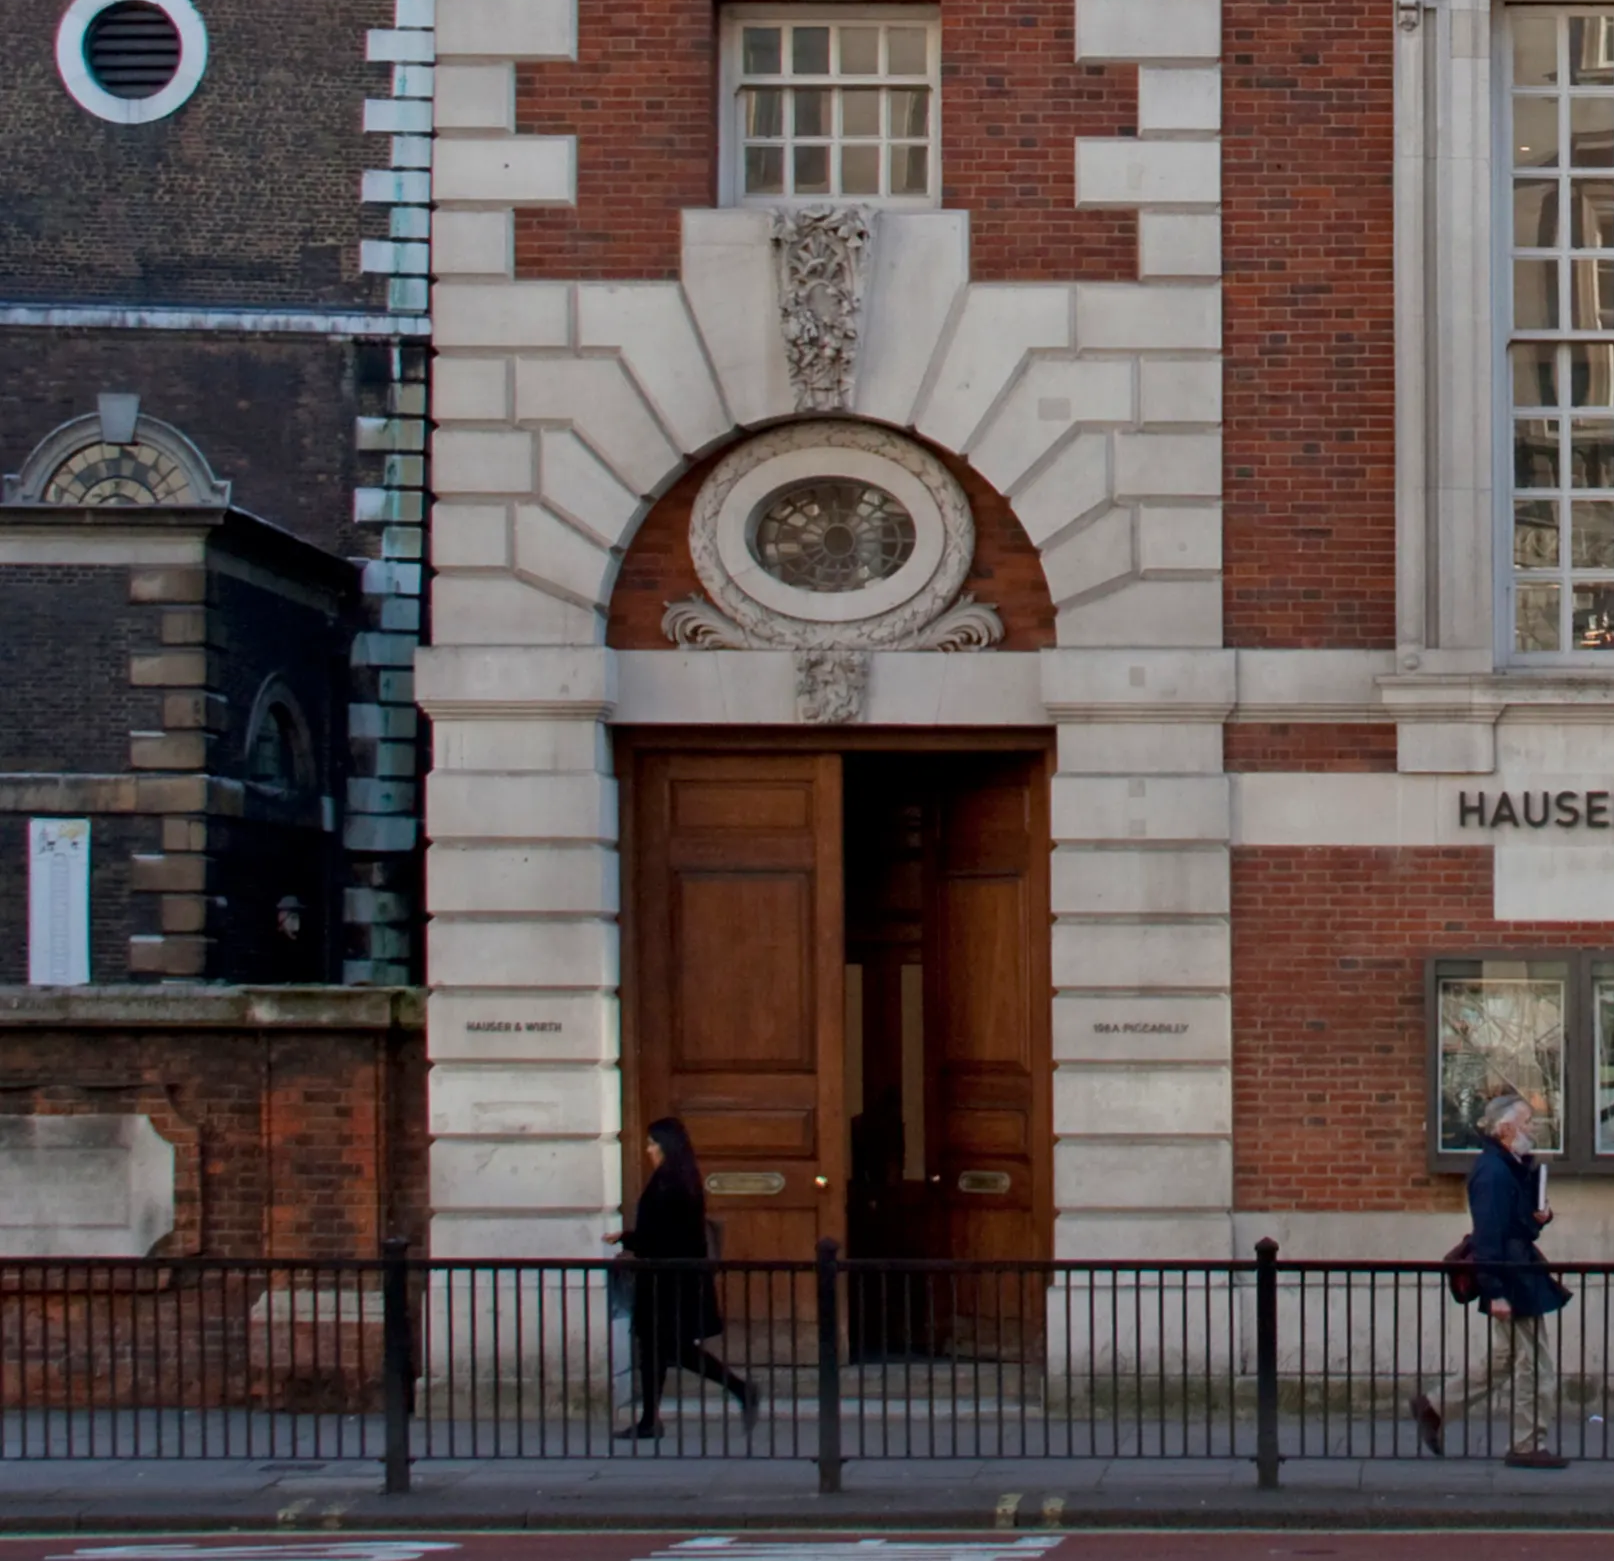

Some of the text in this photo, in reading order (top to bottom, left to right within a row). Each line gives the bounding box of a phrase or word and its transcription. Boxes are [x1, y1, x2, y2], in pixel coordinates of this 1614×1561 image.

[466, 1021, 562, 1032] HAUSER & WIRTH
[1122, 1023, 1189, 1034] PICCADILLY
